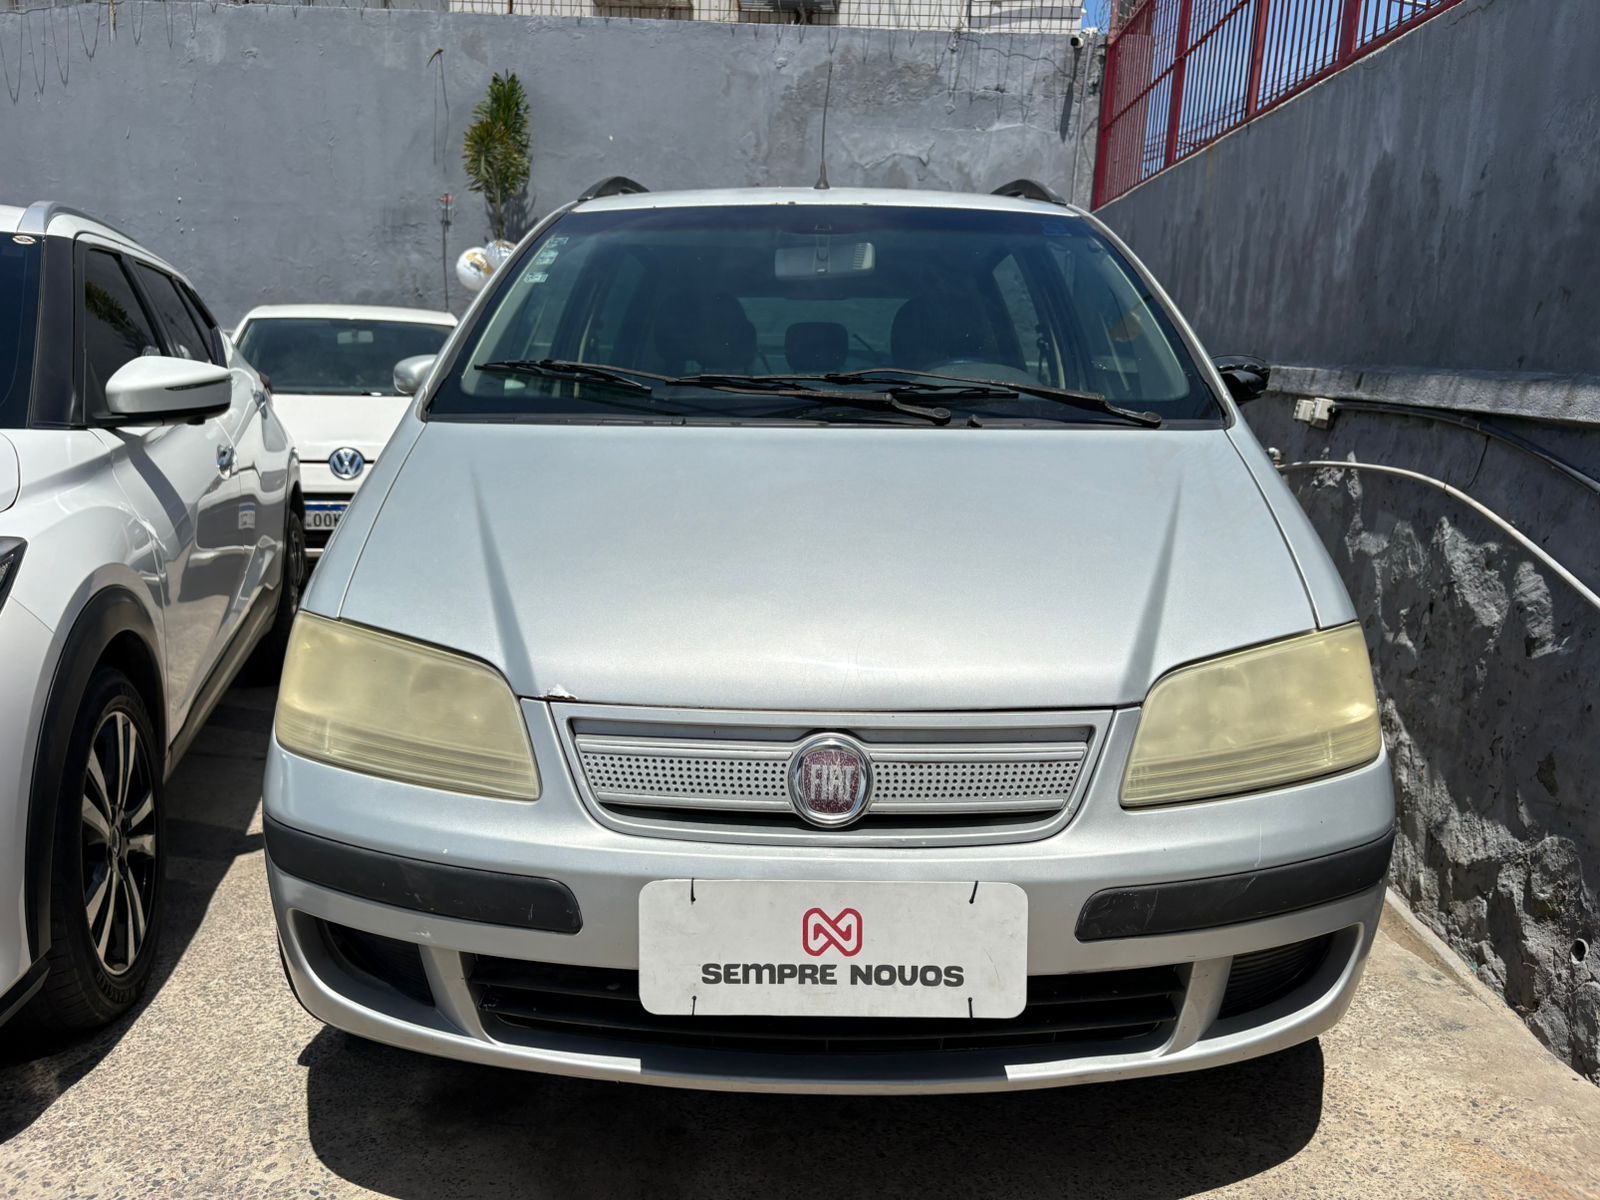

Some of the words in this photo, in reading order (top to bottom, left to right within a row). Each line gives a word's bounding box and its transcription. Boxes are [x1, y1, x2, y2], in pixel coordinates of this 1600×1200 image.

[810, 763, 856, 801] FIAT
[701, 962, 838, 986] SEMPRE
[850, 963, 965, 988] NOVOS
